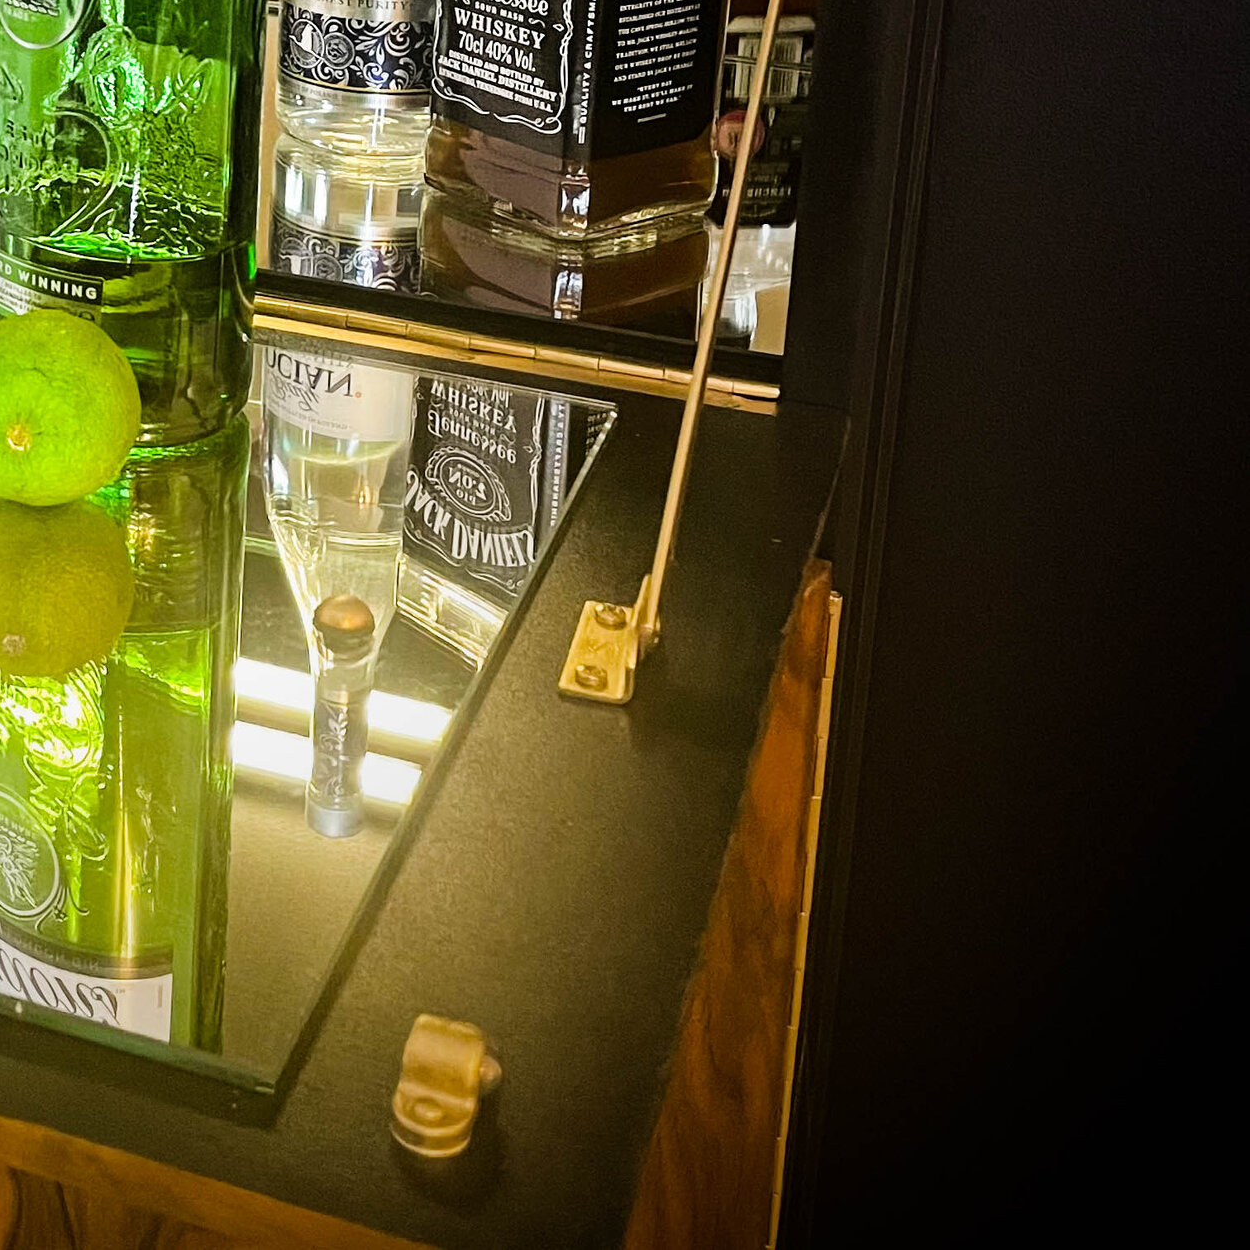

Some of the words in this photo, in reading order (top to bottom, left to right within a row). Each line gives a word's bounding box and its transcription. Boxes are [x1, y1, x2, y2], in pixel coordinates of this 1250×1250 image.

[358, 0, 408, 11] PURITY
[475, 1, 497, 15] SOUR
[500, 8, 525, 23] MASH
[454, 7, 546, 50] WHISKEY
[458, 30, 484, 55] 70cl
[485, 40, 512, 64] 40%
[514, 47, 536, 72] Vol.
[438, 54, 461, 71] JACK
[461, 62, 497, 83] DANIEL
[497, 75, 558, 102] DISTILLERY
[579, 72, 591, 124] QUALITY
[18, 269, 98, 300] WINNING
